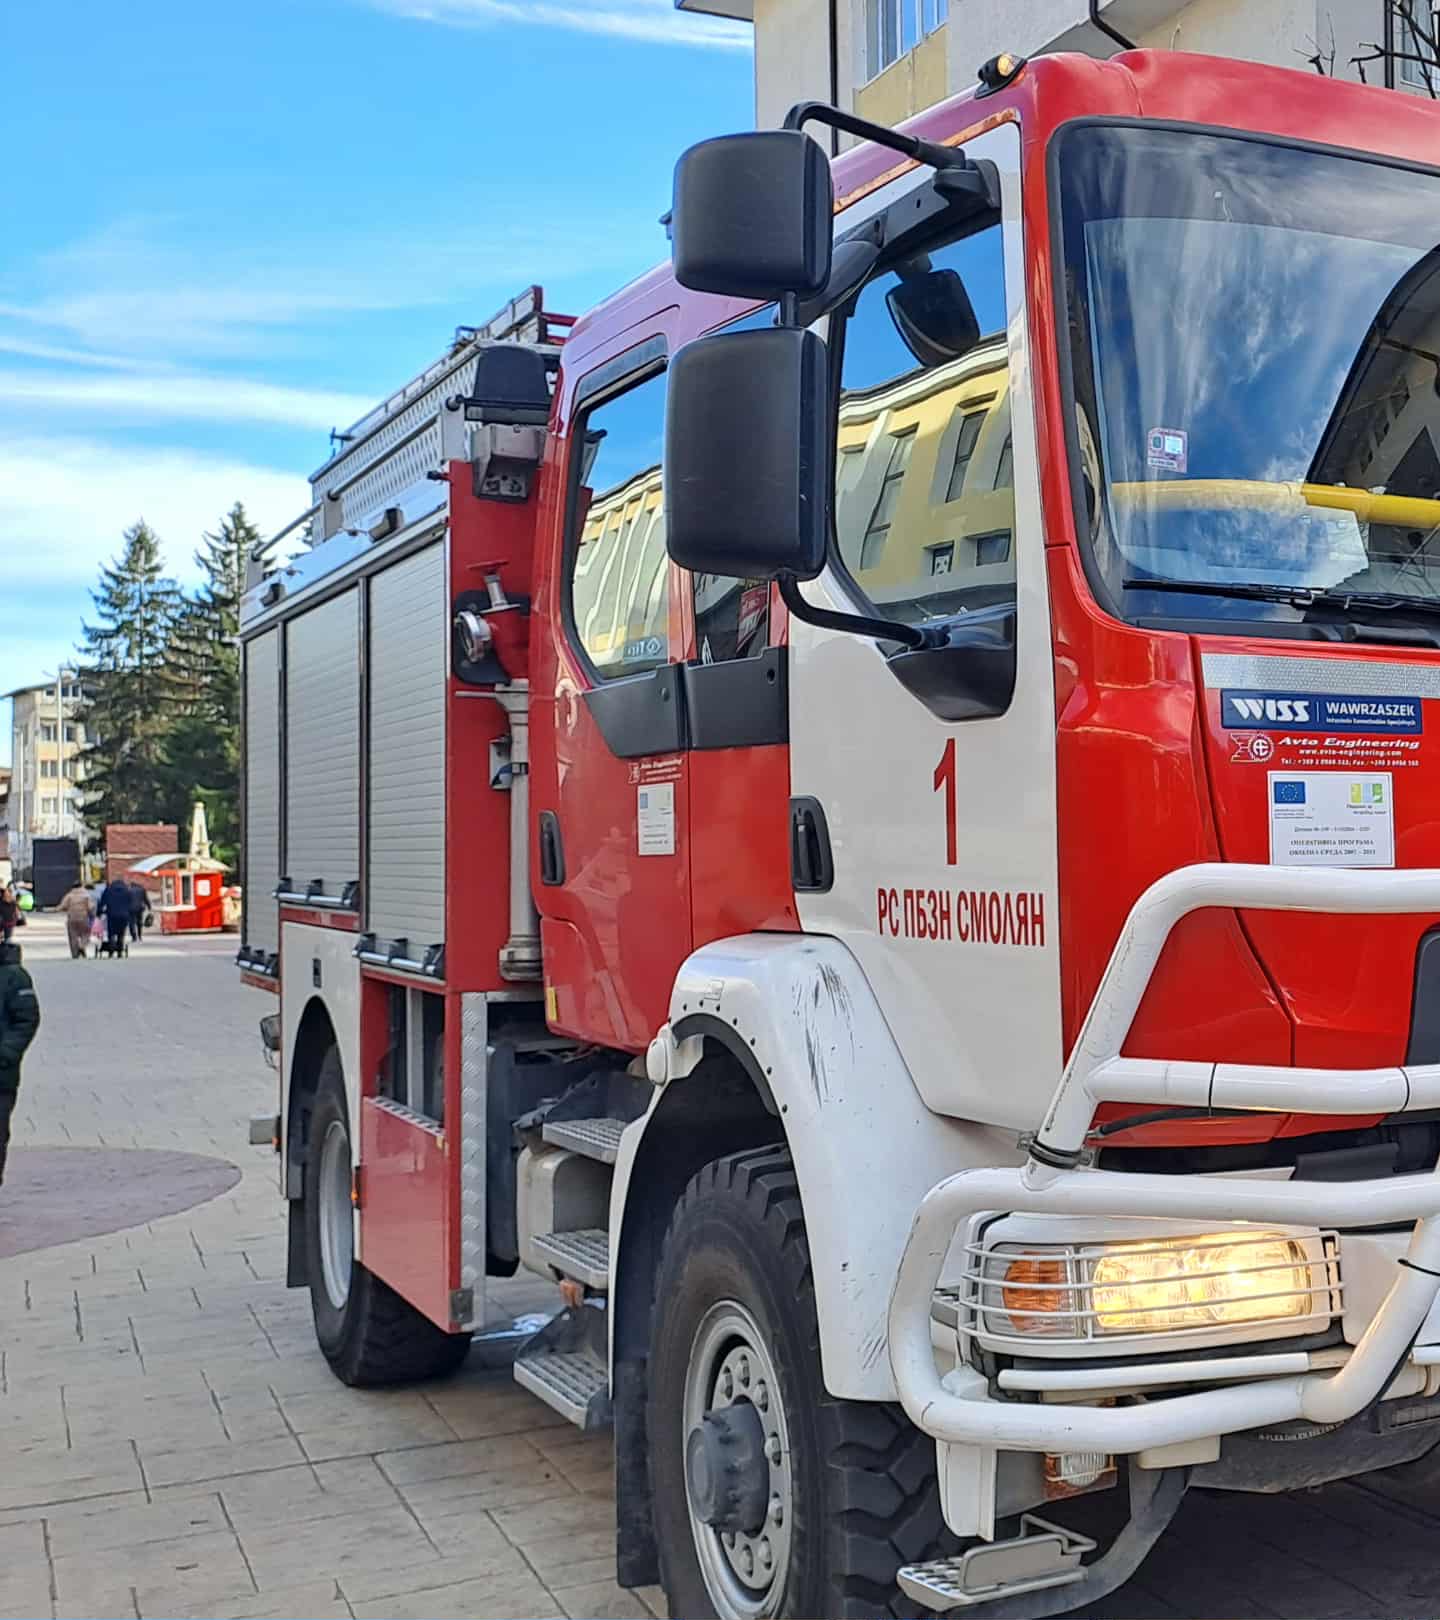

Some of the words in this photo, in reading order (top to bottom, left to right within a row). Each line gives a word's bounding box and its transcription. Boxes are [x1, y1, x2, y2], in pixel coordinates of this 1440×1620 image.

[1231, 698, 1310, 722] WISS
[1326, 702, 1415, 717] WAWRZASZEK
[1278, 737, 1318, 745] Avto
[1323, 737, 1420, 749] Engineering
[933, 737, 957, 865] 1
[878, 888, 900, 938] РС
[903, 889, 952, 940] ПБЗН
[956, 891, 1046, 947] СМОЛЯН
